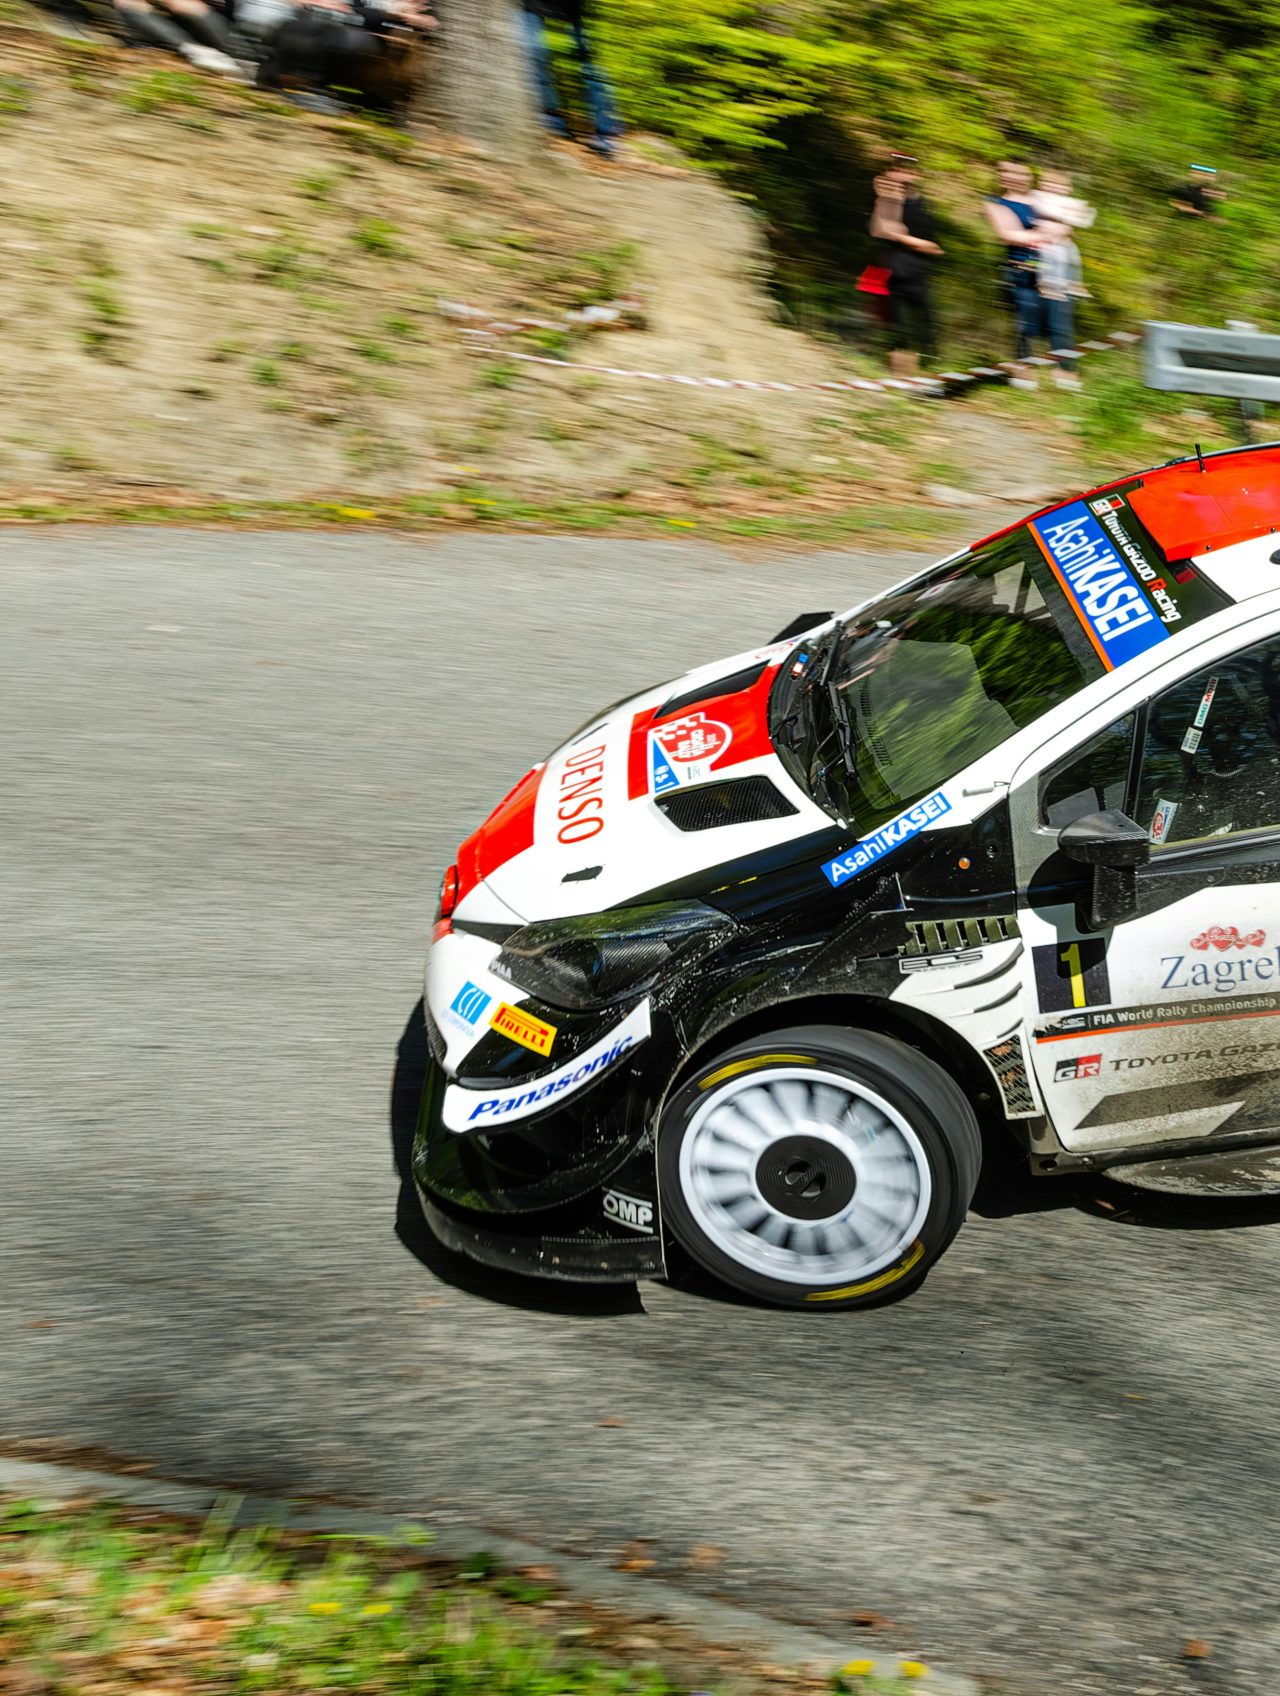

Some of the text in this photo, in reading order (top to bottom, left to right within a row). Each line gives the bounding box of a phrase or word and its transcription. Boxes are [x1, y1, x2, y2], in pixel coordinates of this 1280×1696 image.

[1043, 515, 1154, 642] AsahiKASEI
[1146, 577, 1182, 623] Racing
[557, 744, 606, 844] DENSO
[490, 960, 512, 979] PIAA
[1060, 943, 1086, 1008] 1
[494, 1007, 549, 1048] PIRELLI
[1093, 1014, 1115, 1026] FIA
[1117, 1008, 1154, 1022] World
[1156, 1003, 1188, 1018] Rally
[1191, 996, 1277, 1014] Championship
[468, 1036, 633, 1121] Panasonic
[1109, 1050, 1213, 1071] TOYOTA
[603, 1193, 653, 1226] OMP
